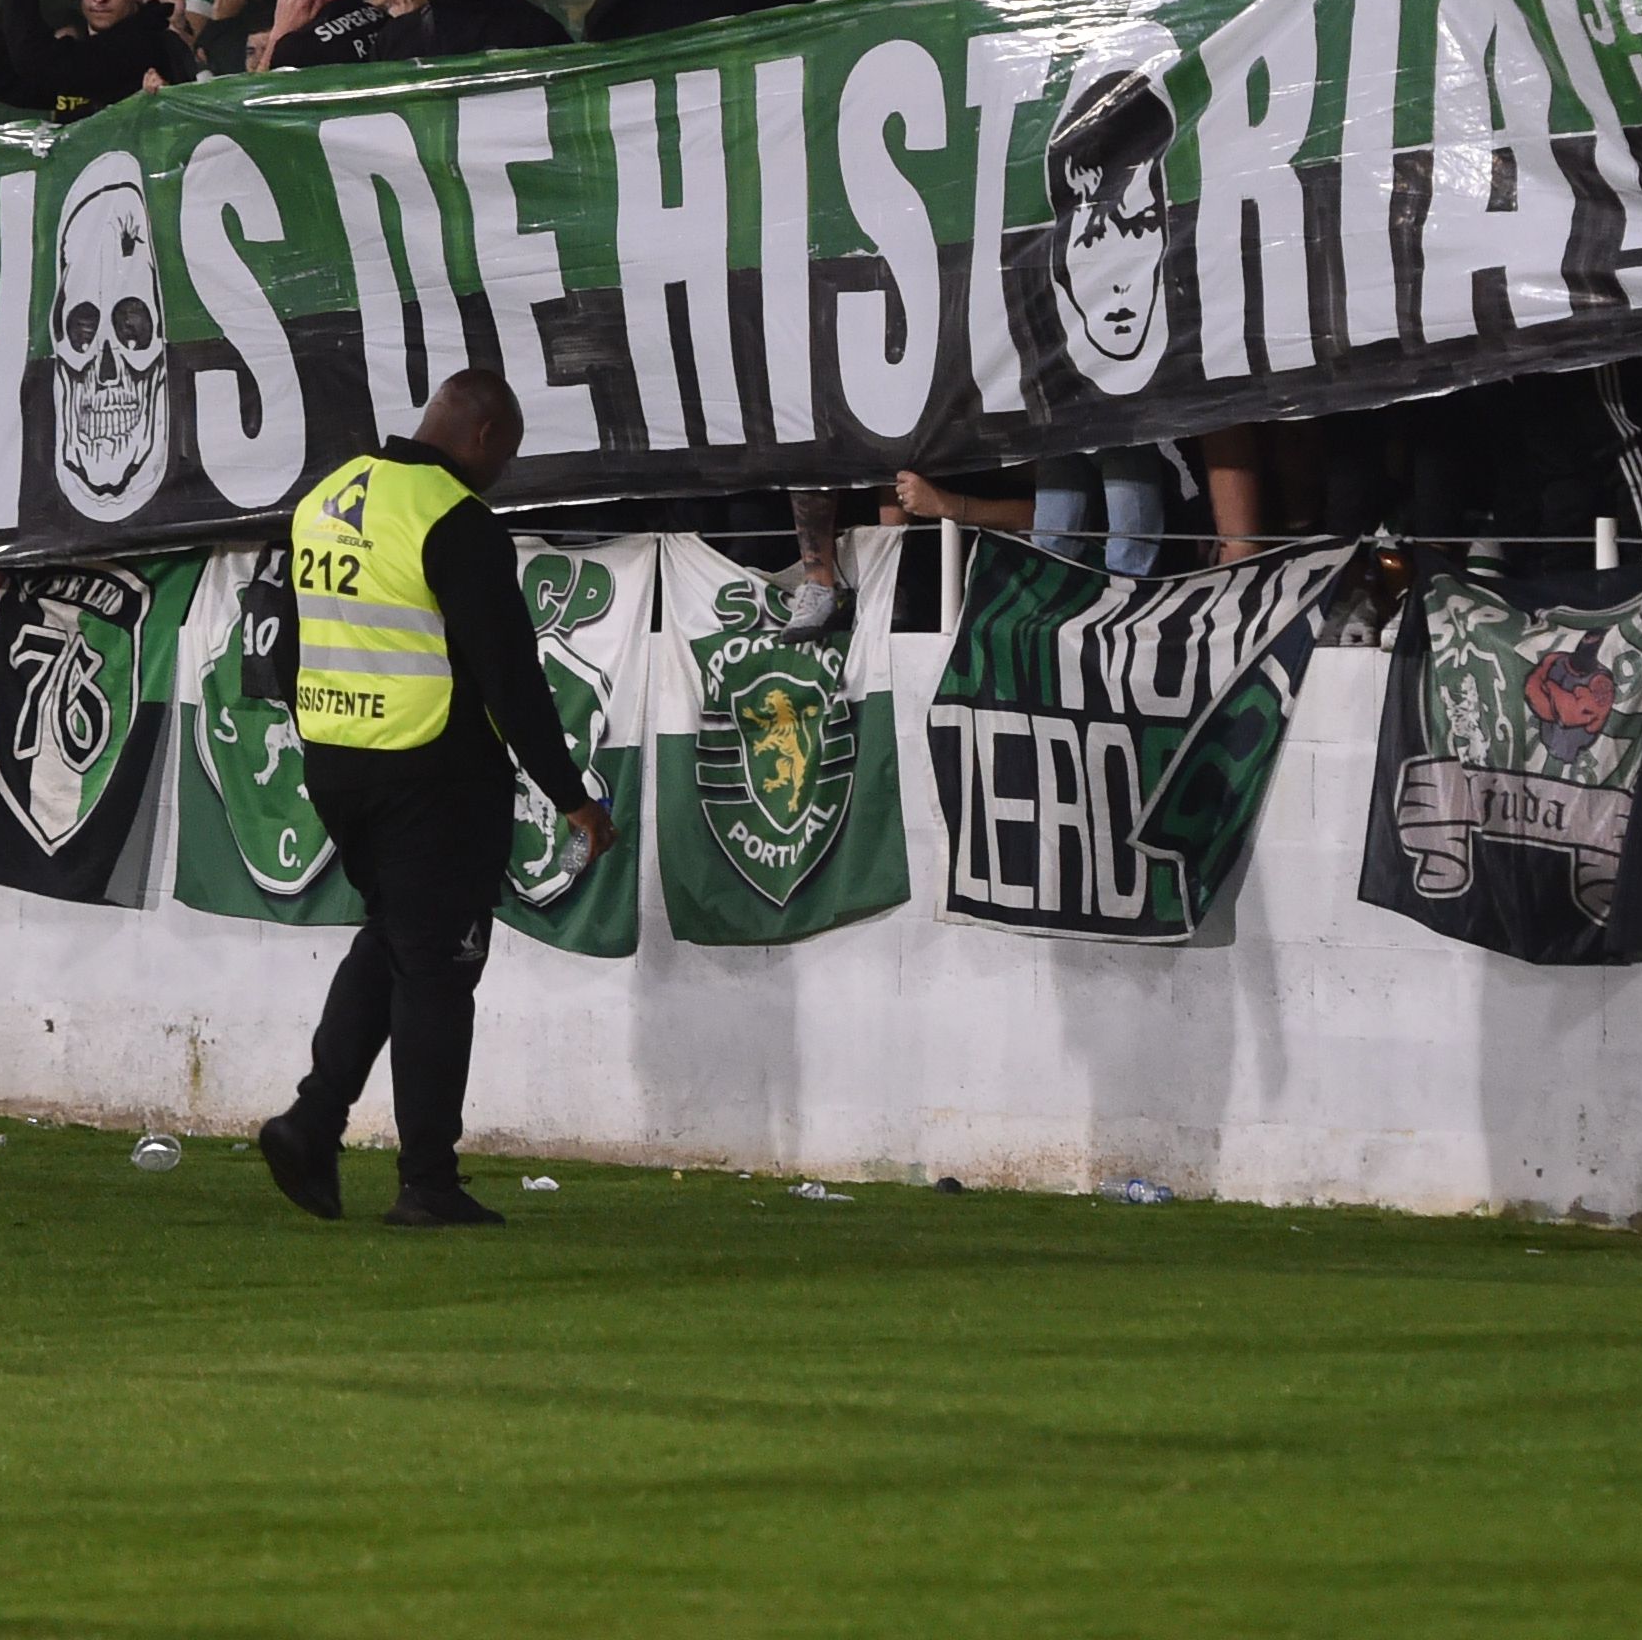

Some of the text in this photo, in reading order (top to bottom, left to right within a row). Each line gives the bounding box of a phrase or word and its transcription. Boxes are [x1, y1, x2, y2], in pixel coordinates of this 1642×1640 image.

[318, 84, 600, 456] DE
[299, 548, 361, 587] 212
[9, 624, 111, 775] 76
[929, 703, 1148, 920] ZERO
